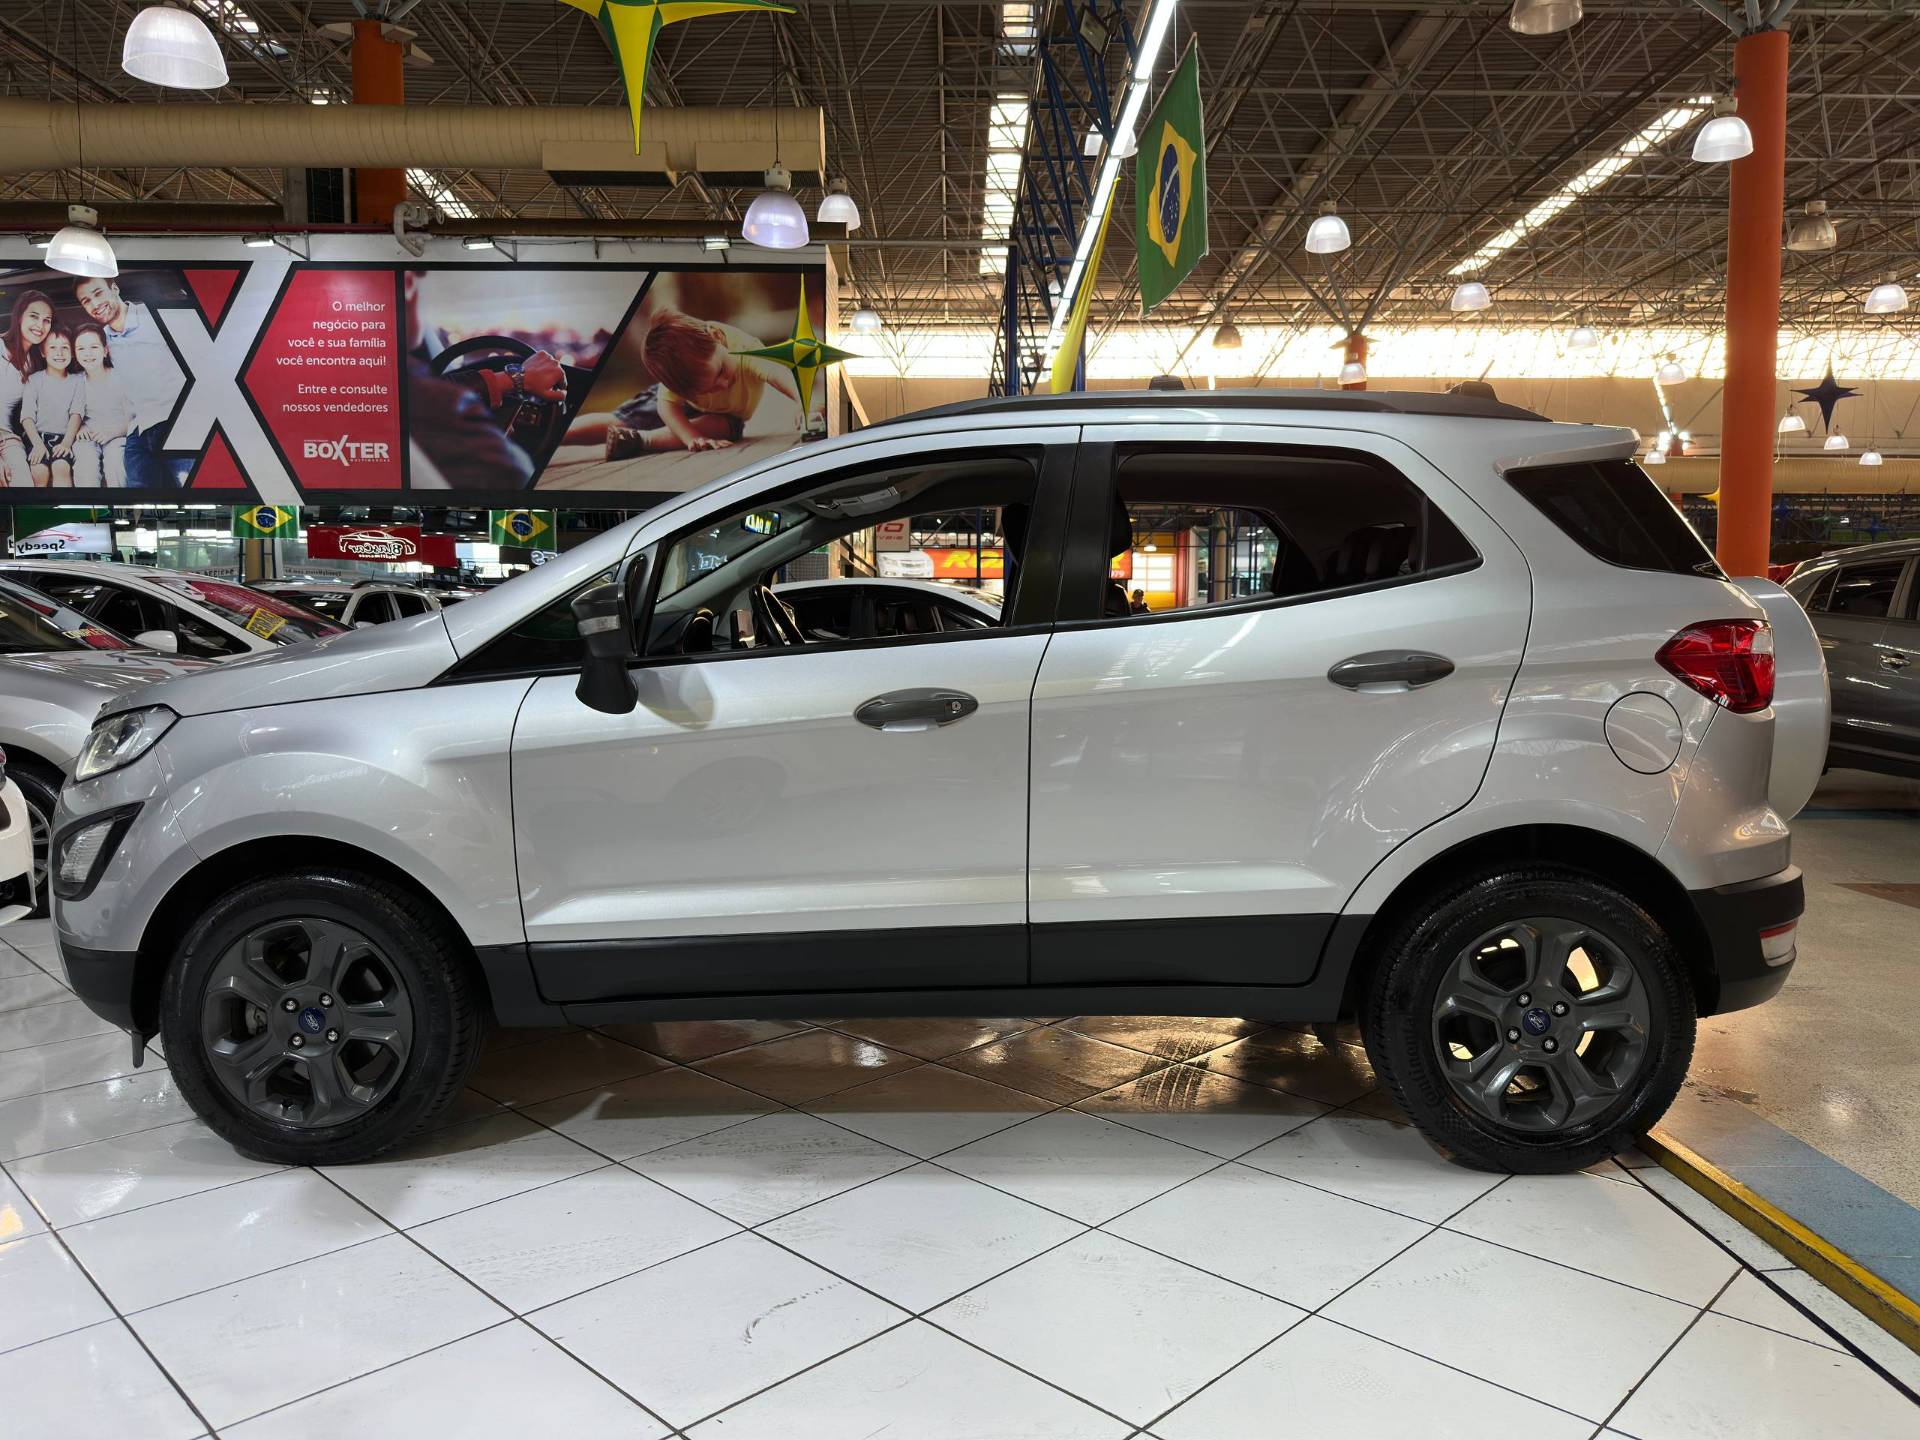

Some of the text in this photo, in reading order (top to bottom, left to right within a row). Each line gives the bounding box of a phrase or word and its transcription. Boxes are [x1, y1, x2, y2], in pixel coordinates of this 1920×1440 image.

[332, 301, 386, 312] O melhor
[312, 320, 386, 332] negócio para
[287, 337, 387, 348] você e sua família
[276, 355, 387, 368] você encontra aqui!
[298, 384, 388, 394] Entre e consulte
[282, 402, 389, 412] nossos vendedores
[303, 434, 390, 467] BOXTER
